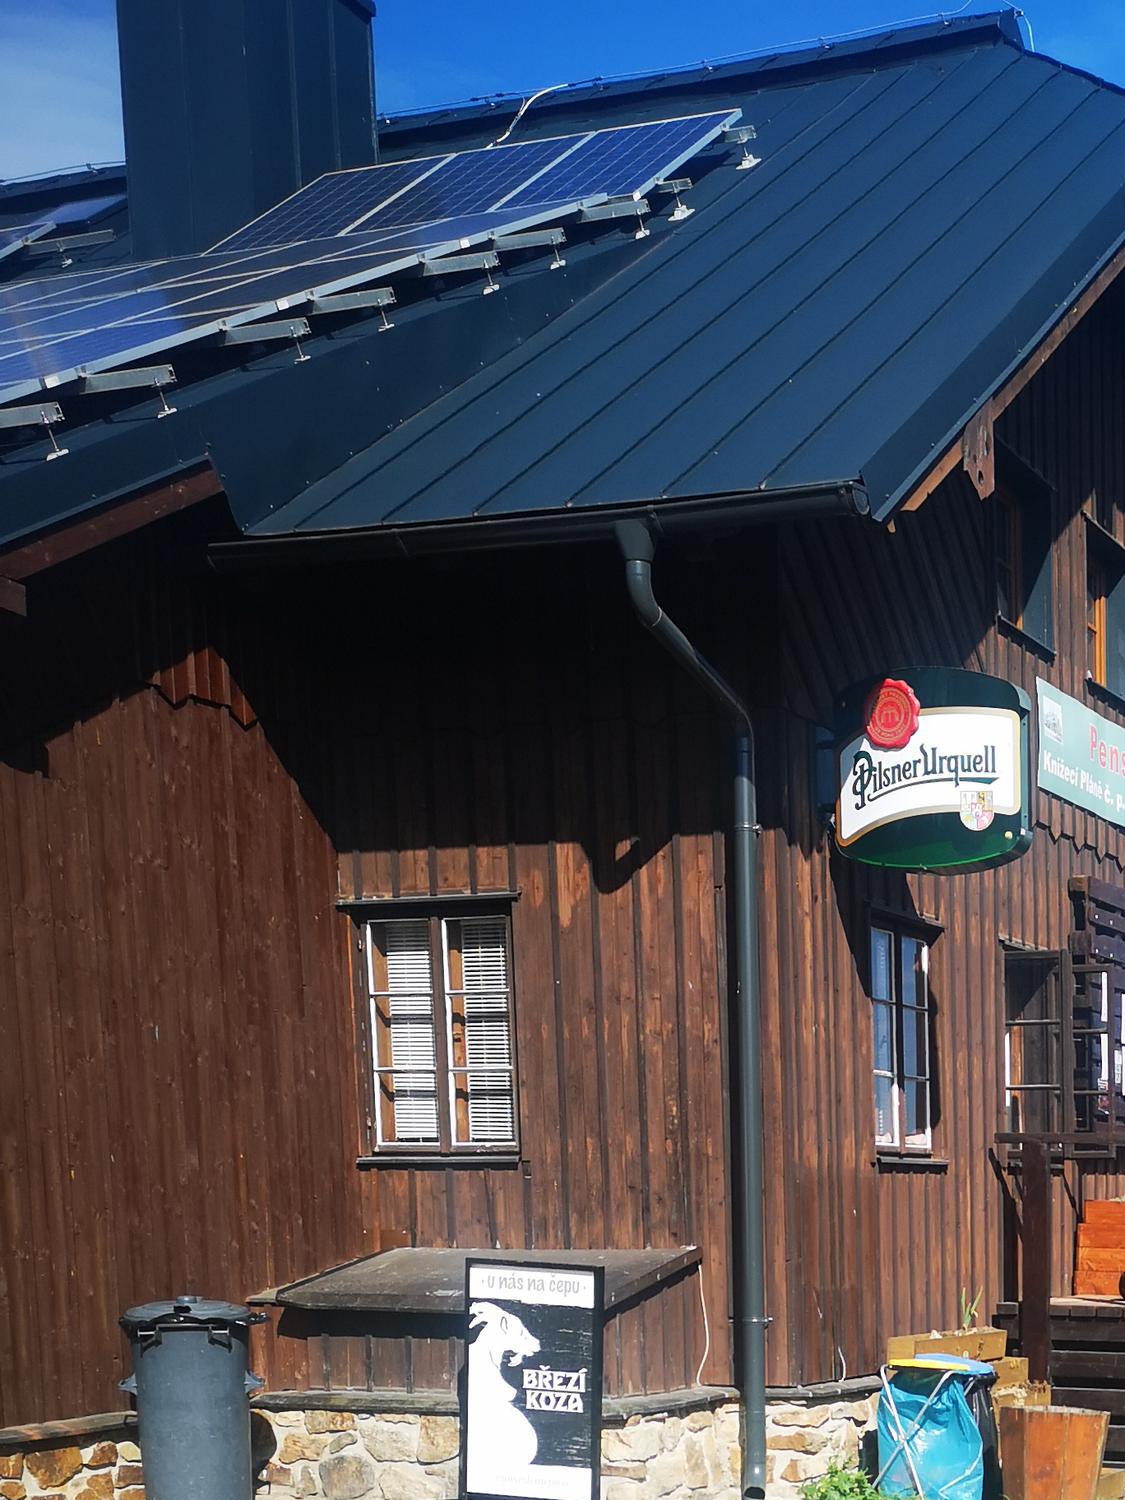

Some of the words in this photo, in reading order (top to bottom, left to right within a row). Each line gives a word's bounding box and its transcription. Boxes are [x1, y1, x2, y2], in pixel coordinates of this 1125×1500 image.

[852, 750, 921, 811] Pilsner
[919, 743, 997, 788] Urquell
[1116, 794, 1125, 813] p.
[487, 1275, 495, 1288] u
[499, 1273, 524, 1290] nás
[527, 1277, 545, 1291] na
[549, 1272, 580, 1297] čepu
[522, 1365, 588, 1392] BŘEZÍ
[526, 1390, 583, 1413] KOZA
